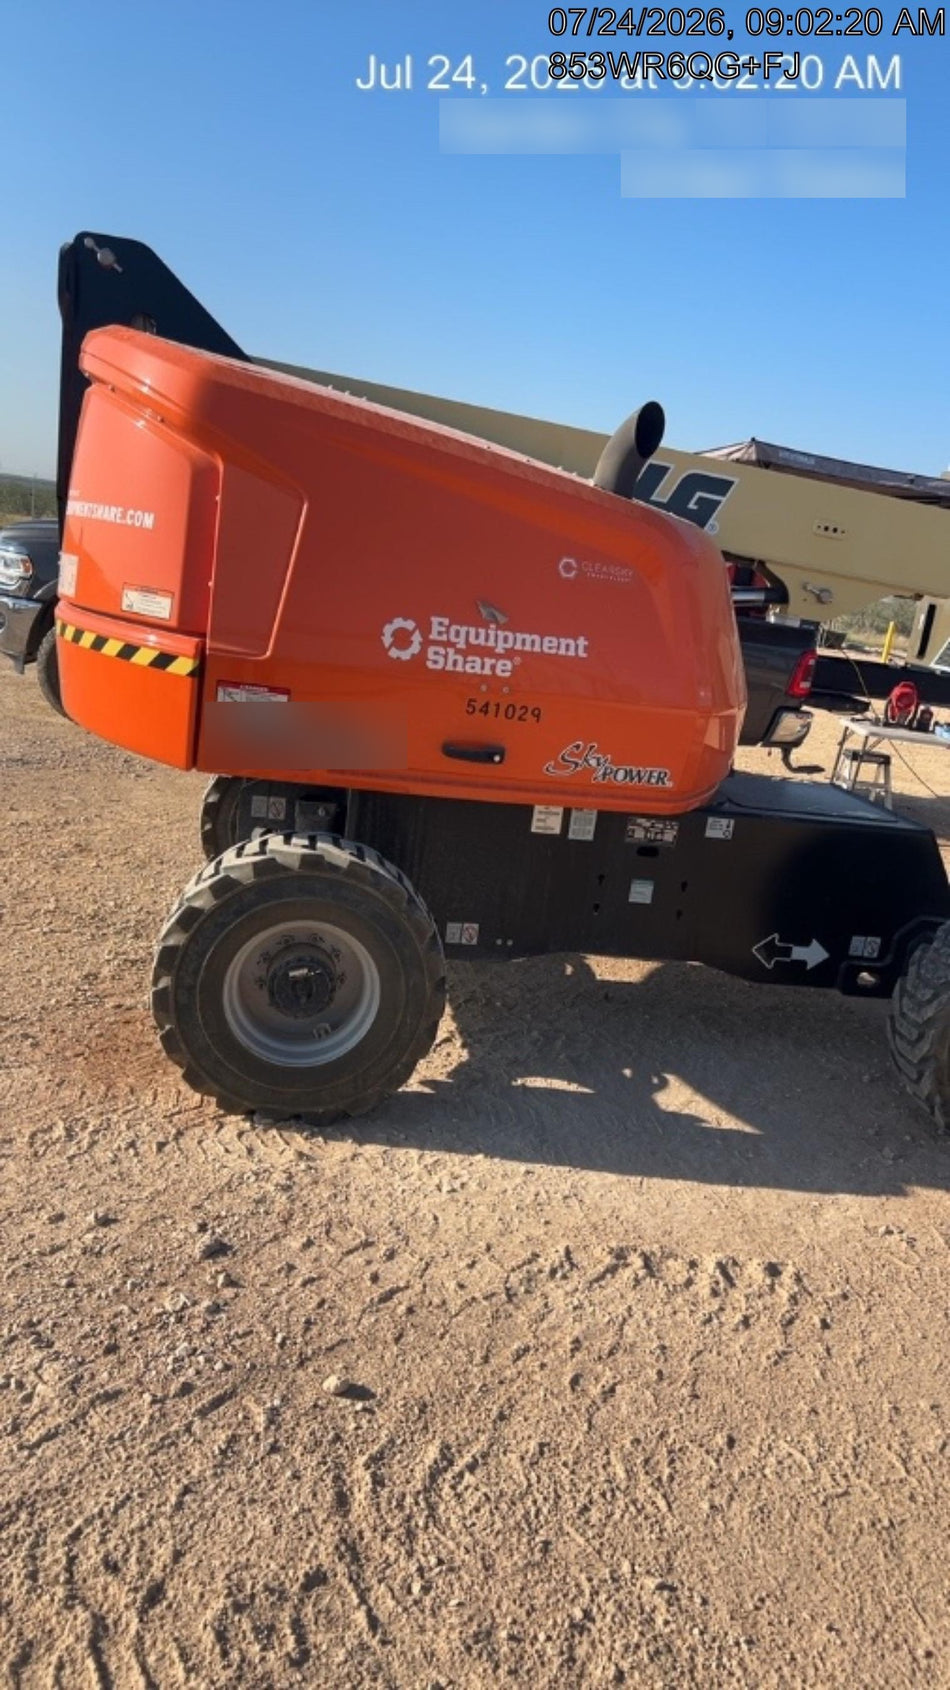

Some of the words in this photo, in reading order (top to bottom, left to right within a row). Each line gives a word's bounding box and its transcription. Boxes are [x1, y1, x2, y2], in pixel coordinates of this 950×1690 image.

[632, 460, 739, 531] LG
[428, 616, 588, 658] Equipment
[425, 646, 513, 677] Share
[465, 699, 542, 723] 541029
[543, 740, 611, 783] Sky
